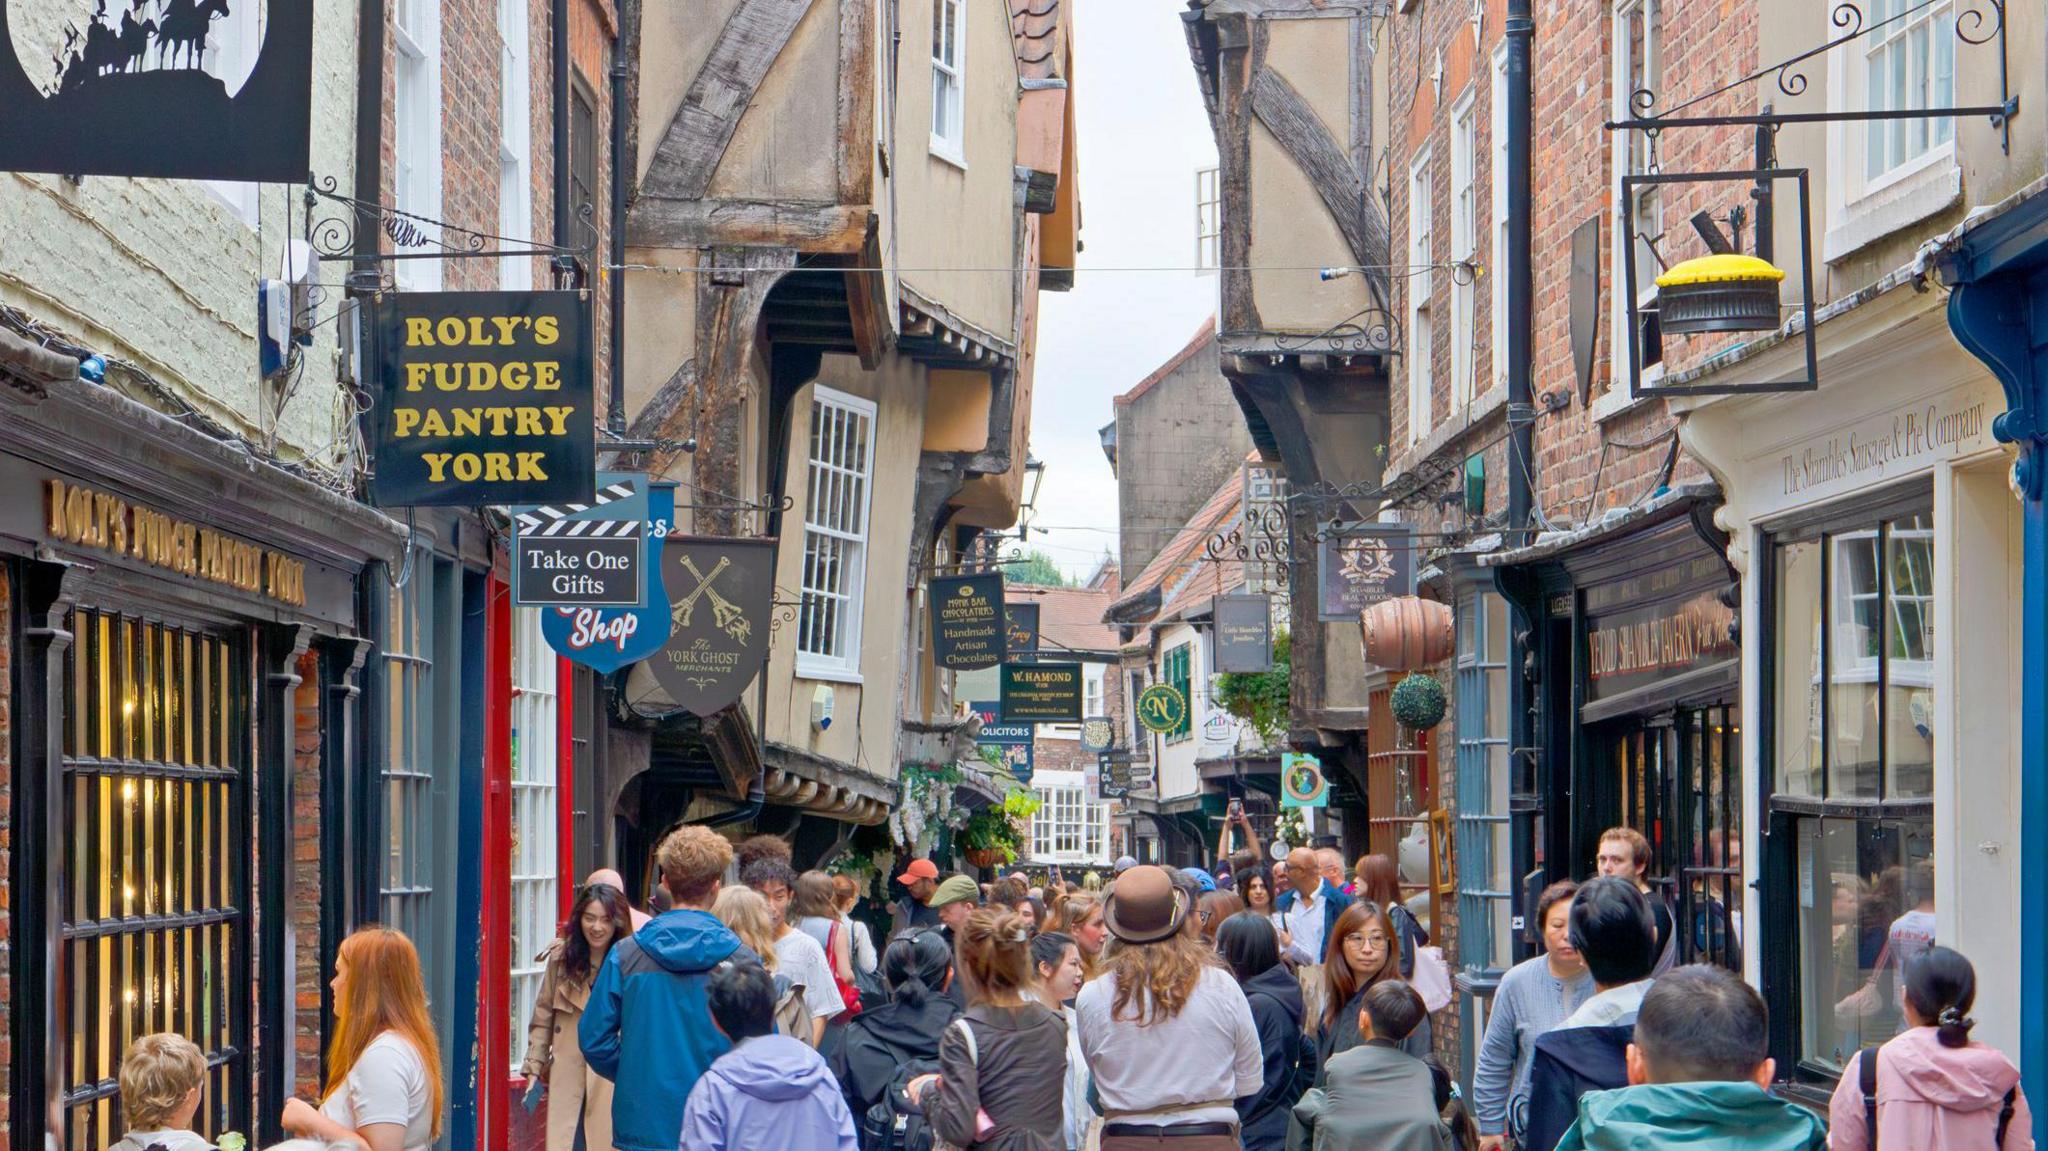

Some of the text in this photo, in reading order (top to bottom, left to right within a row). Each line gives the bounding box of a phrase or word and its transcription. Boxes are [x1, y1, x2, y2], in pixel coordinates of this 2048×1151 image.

[405, 316, 560, 346] ROLY'S
[405, 361, 561, 391] FUDGE
[393, 407, 574, 437] PANTRY
[1782, 402, 1985, 495] The Shambles Sausage & Pie Company
[421, 452, 549, 482] YORK
[133, 506, 197, 577] FUDGE
[200, 528, 263, 593] PANTRY
[267, 551, 307, 608] YORK
[527, 550, 630, 570] Take One
[551, 574, 605, 594] Gifts
[947, 596, 987, 608] MONK BAR
[942, 606, 994, 618] CHOCOLATIERS
[571, 607, 638, 650] Shop
[944, 626, 995, 639] Handmade
[691, 638, 710, 651] The
[955, 641, 987, 650] Artisan
[1619, 620, 1660, 670] SHAMBLES
[1660, 609, 1693, 664] TAVERN
[666, 650, 740, 665] YORK GHOST
[946, 652, 998, 664] Chocolates
[675, 664, 732, 673] MERCHANTS
[1025, 672, 1072, 682] HAMOND
[981, 727, 1030, 737] OLICITORS
